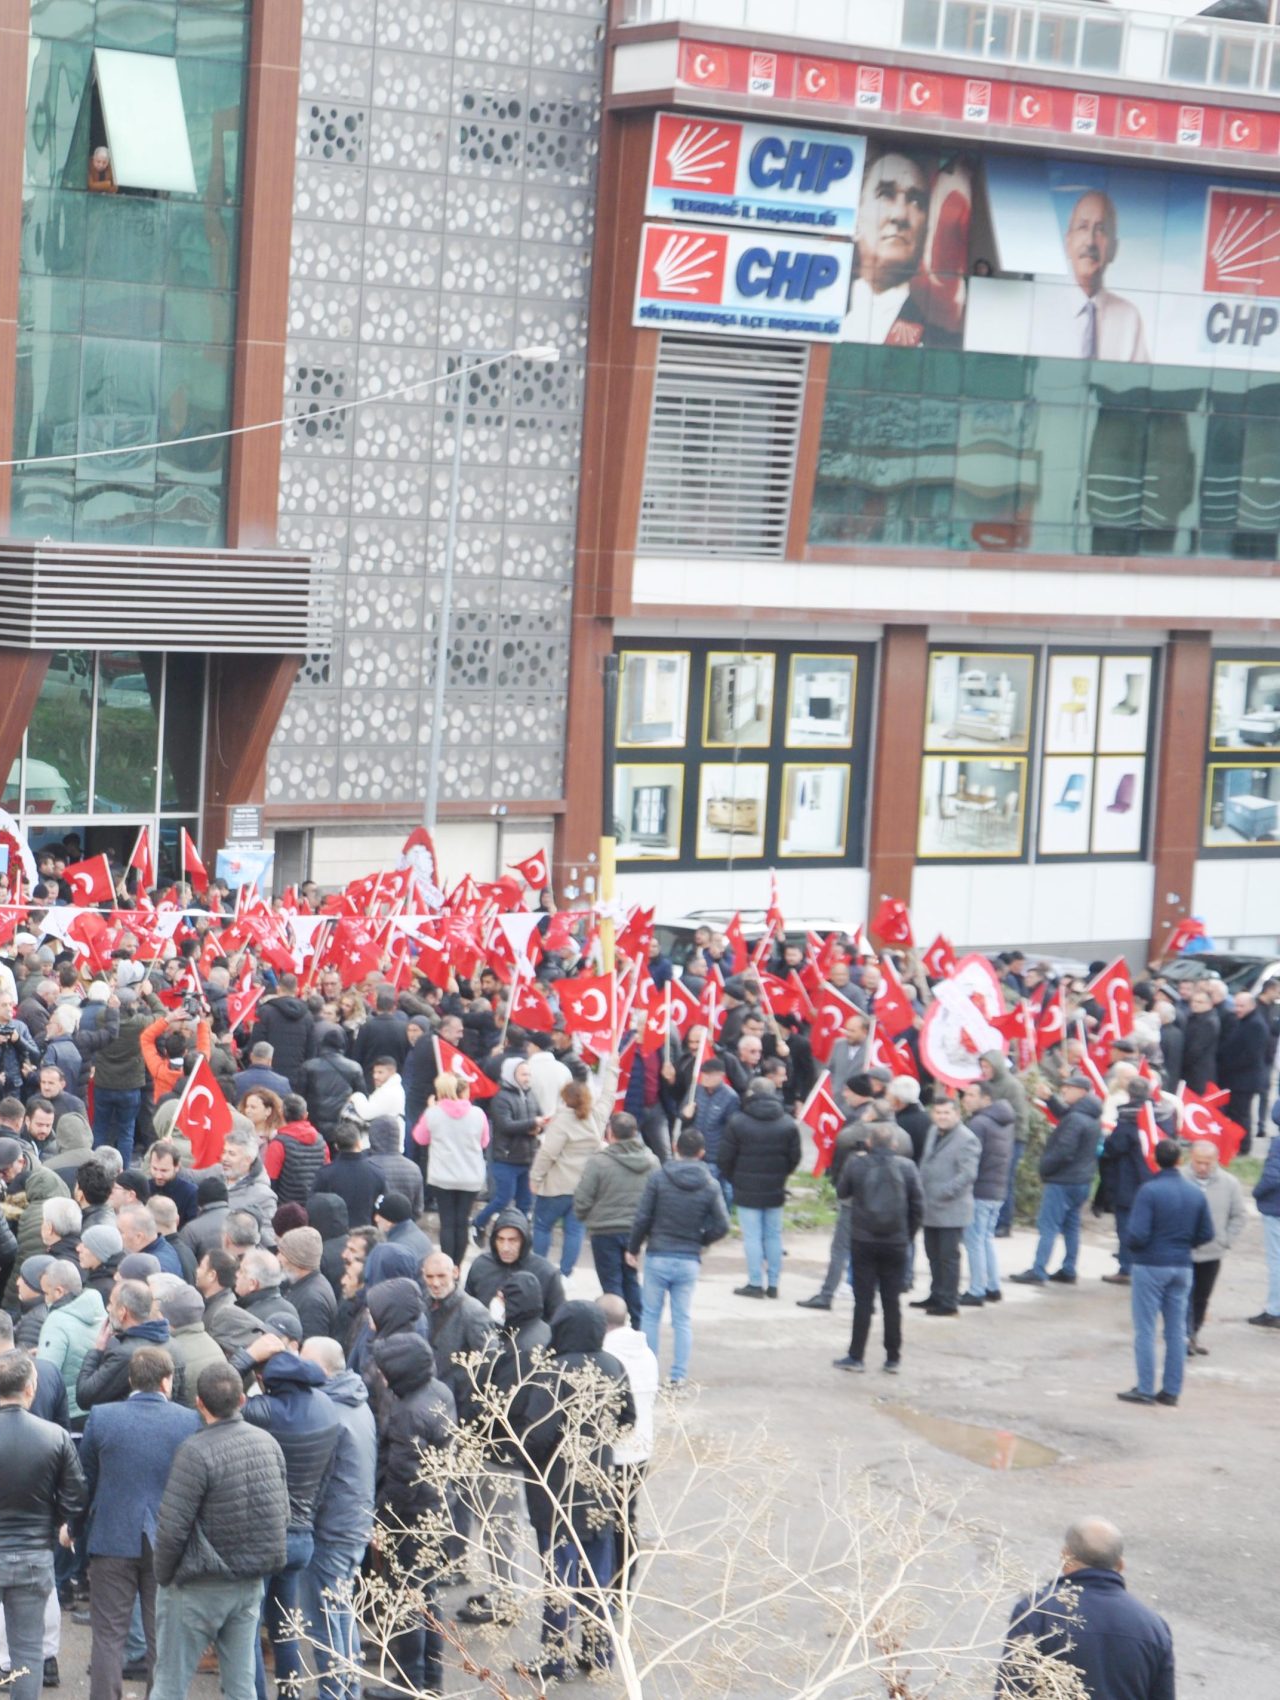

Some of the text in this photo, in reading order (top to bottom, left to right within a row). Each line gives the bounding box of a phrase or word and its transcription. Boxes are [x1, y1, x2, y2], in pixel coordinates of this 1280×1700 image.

[749, 136, 854, 194] CHP
[735, 246, 840, 303] CHP
[1206, 302, 1279, 347] CHP
